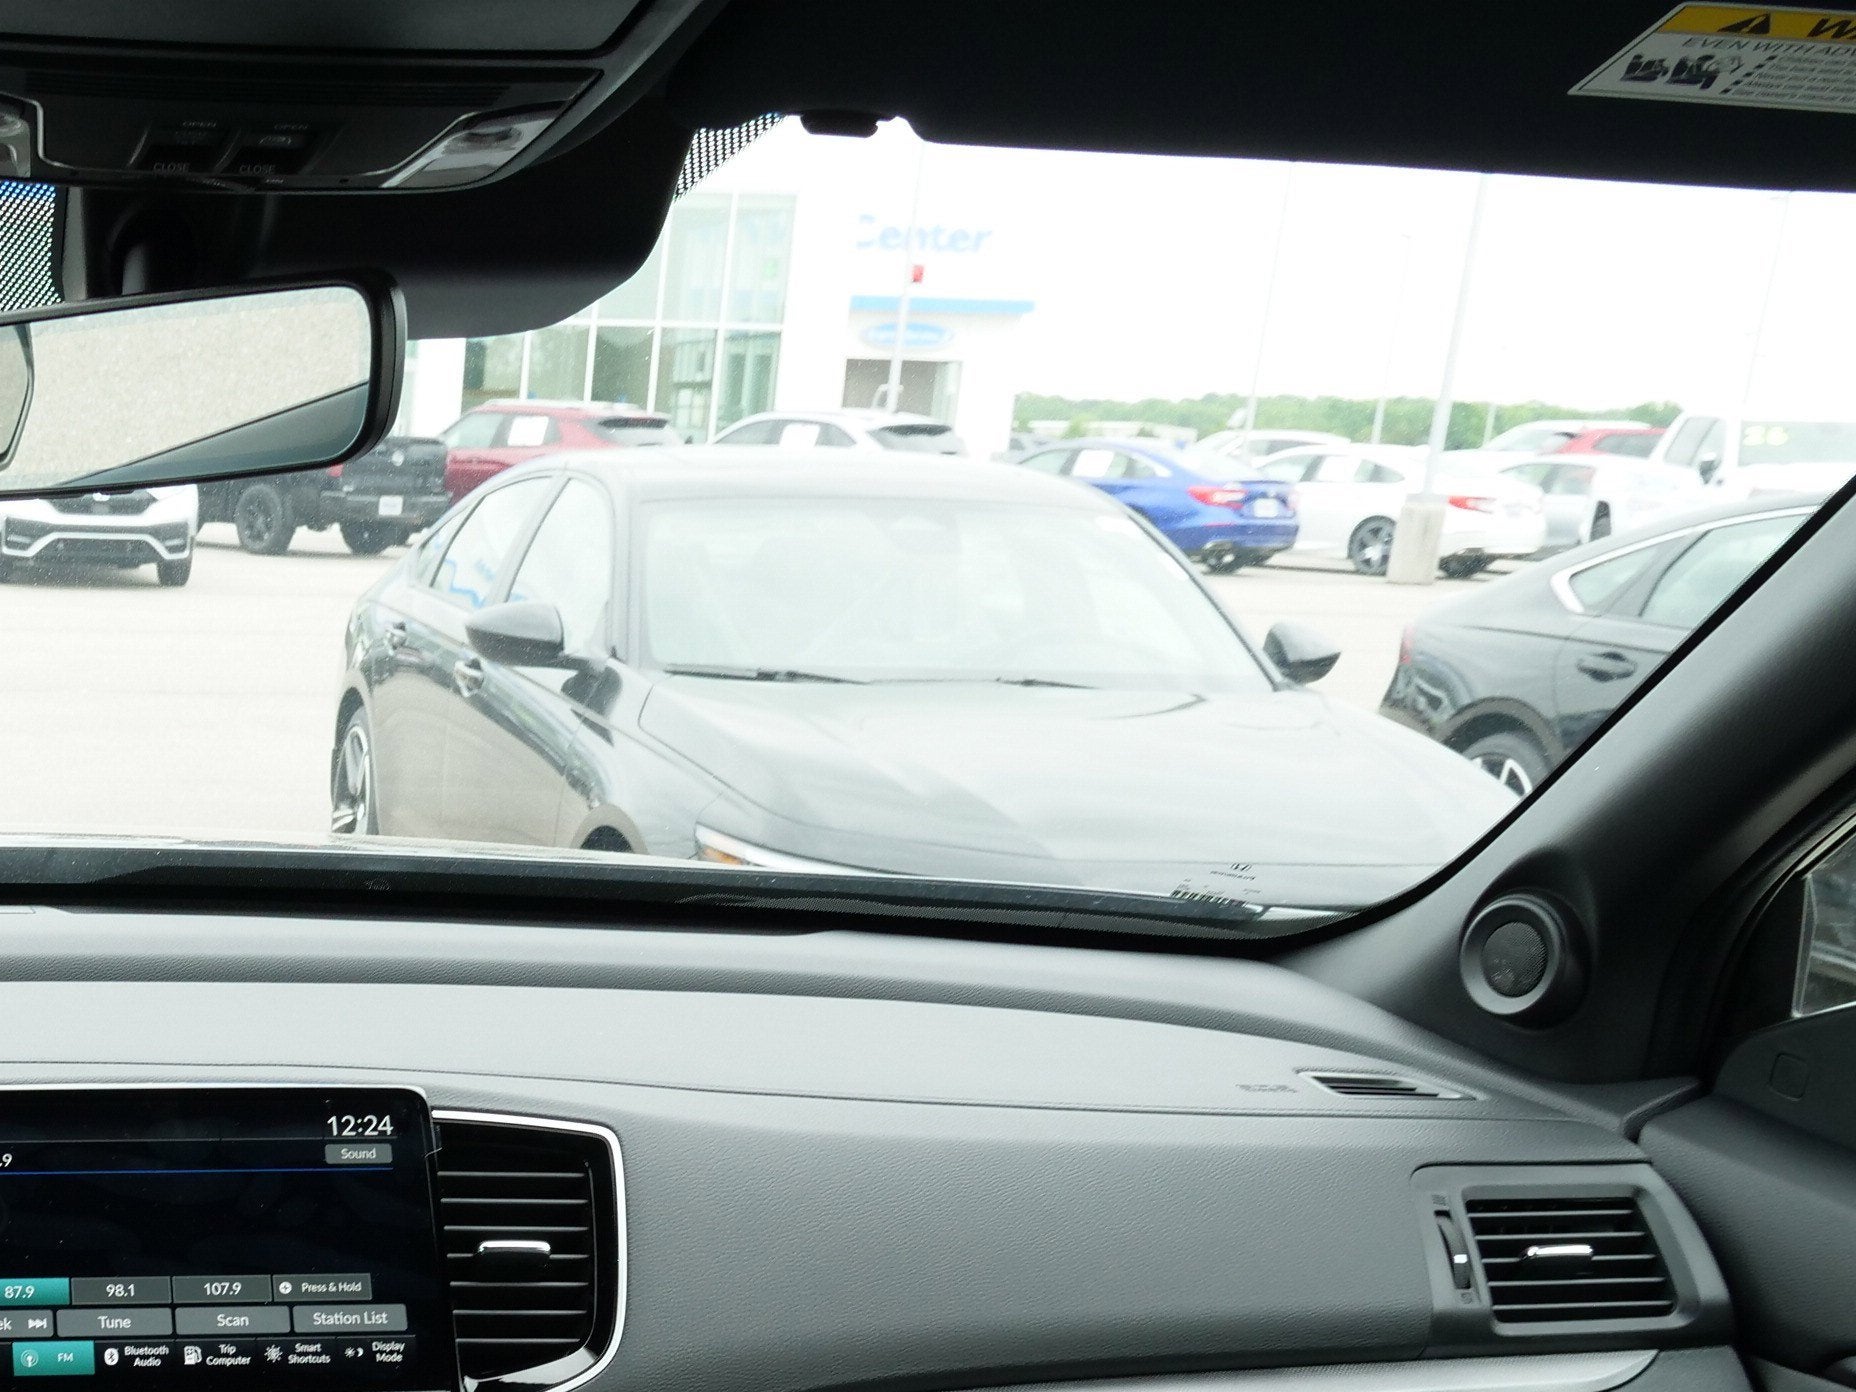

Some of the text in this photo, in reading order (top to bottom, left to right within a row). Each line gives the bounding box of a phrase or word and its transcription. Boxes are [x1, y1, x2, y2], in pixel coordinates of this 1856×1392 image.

[152, 162, 190, 173] CLOSE
[239, 164, 276, 175] CLOSE
[855, 213, 993, 253] Center
[326, 1114, 395, 1137] 12:24
[340, 1147, 377, 1160] Sound
[4, 1285, 36, 1299] 87.9
[105, 1283, 136, 1298] 98.1
[203, 1282, 242, 1296] 107.9
[301, 1281, 362, 1293] Press & Hold
[97, 1315, 132, 1330] Tune
[216, 1313, 250, 1328] Scan
[312, 1310, 389, 1326] Station List
[124, 1344, 170, 1357] Bluetooth
[218, 1343, 237, 1356] Trip
[294, 1342, 322, 1353] Smart
[371, 1340, 406, 1353] Display
[57, 1353, 74, 1363] FM
[133, 1355, 162, 1368] Audio
[205, 1355, 252, 1368] Computer
[287, 1353, 332, 1365] Shortcuts
[375, 1352, 404, 1364] Mode
